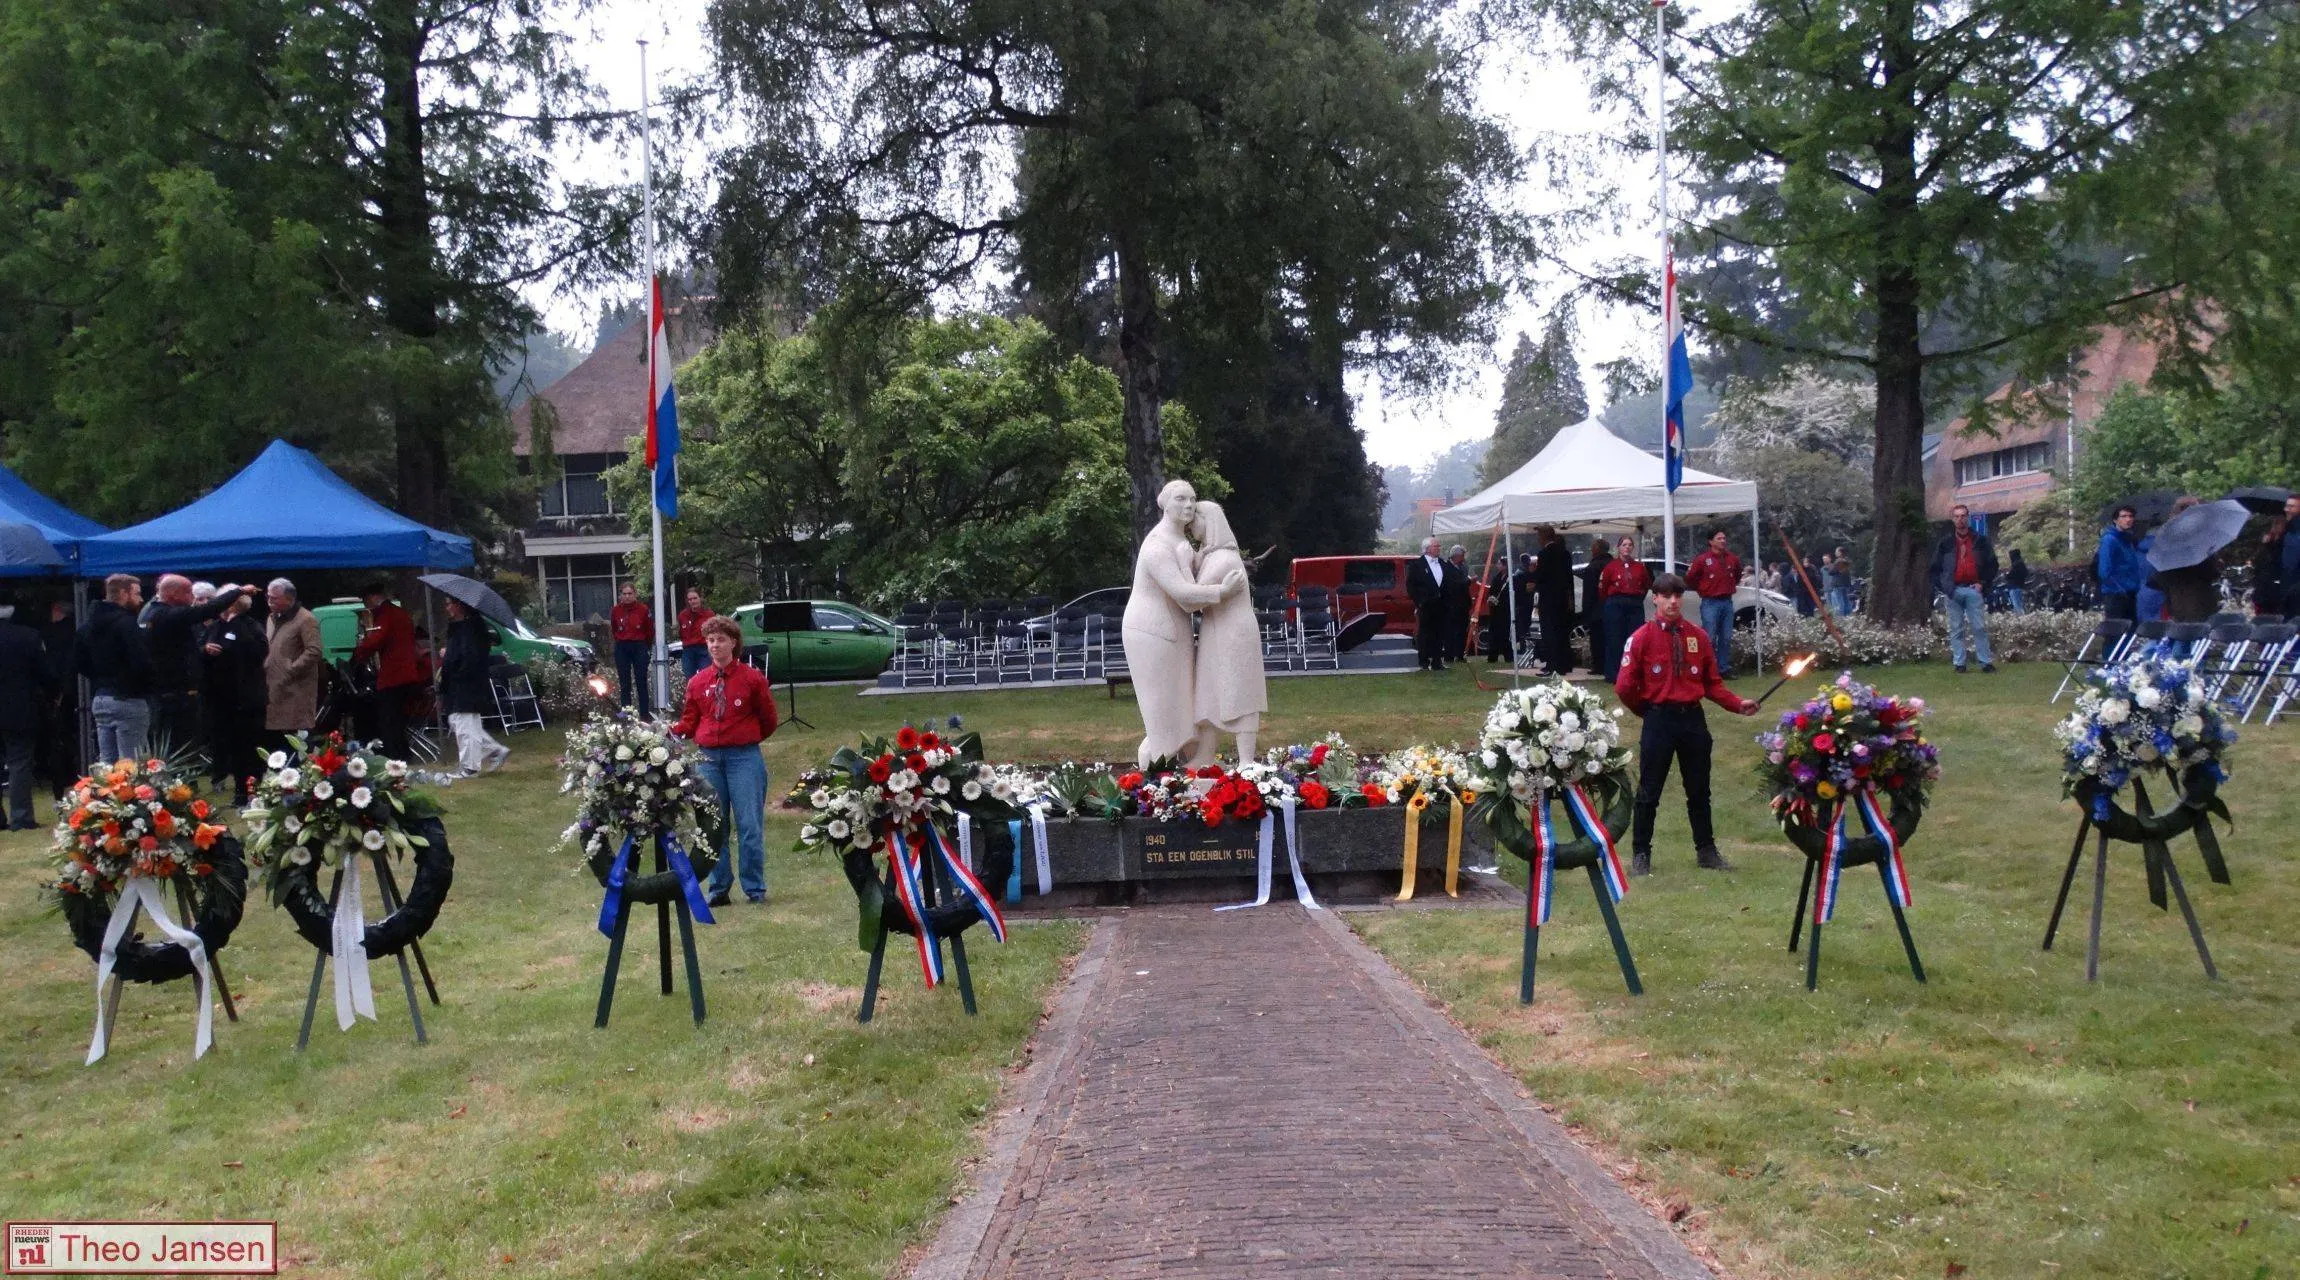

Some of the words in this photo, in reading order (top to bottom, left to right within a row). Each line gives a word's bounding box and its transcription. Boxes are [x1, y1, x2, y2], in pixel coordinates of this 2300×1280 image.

[1145, 834, 1166, 846] 1940
[1146, 851, 1164, 863] STA
[1168, 851, 1186, 862] EEN
[1190, 850, 1232, 861] OGENBLIK
[1236, 849, 1256, 860] STIL
